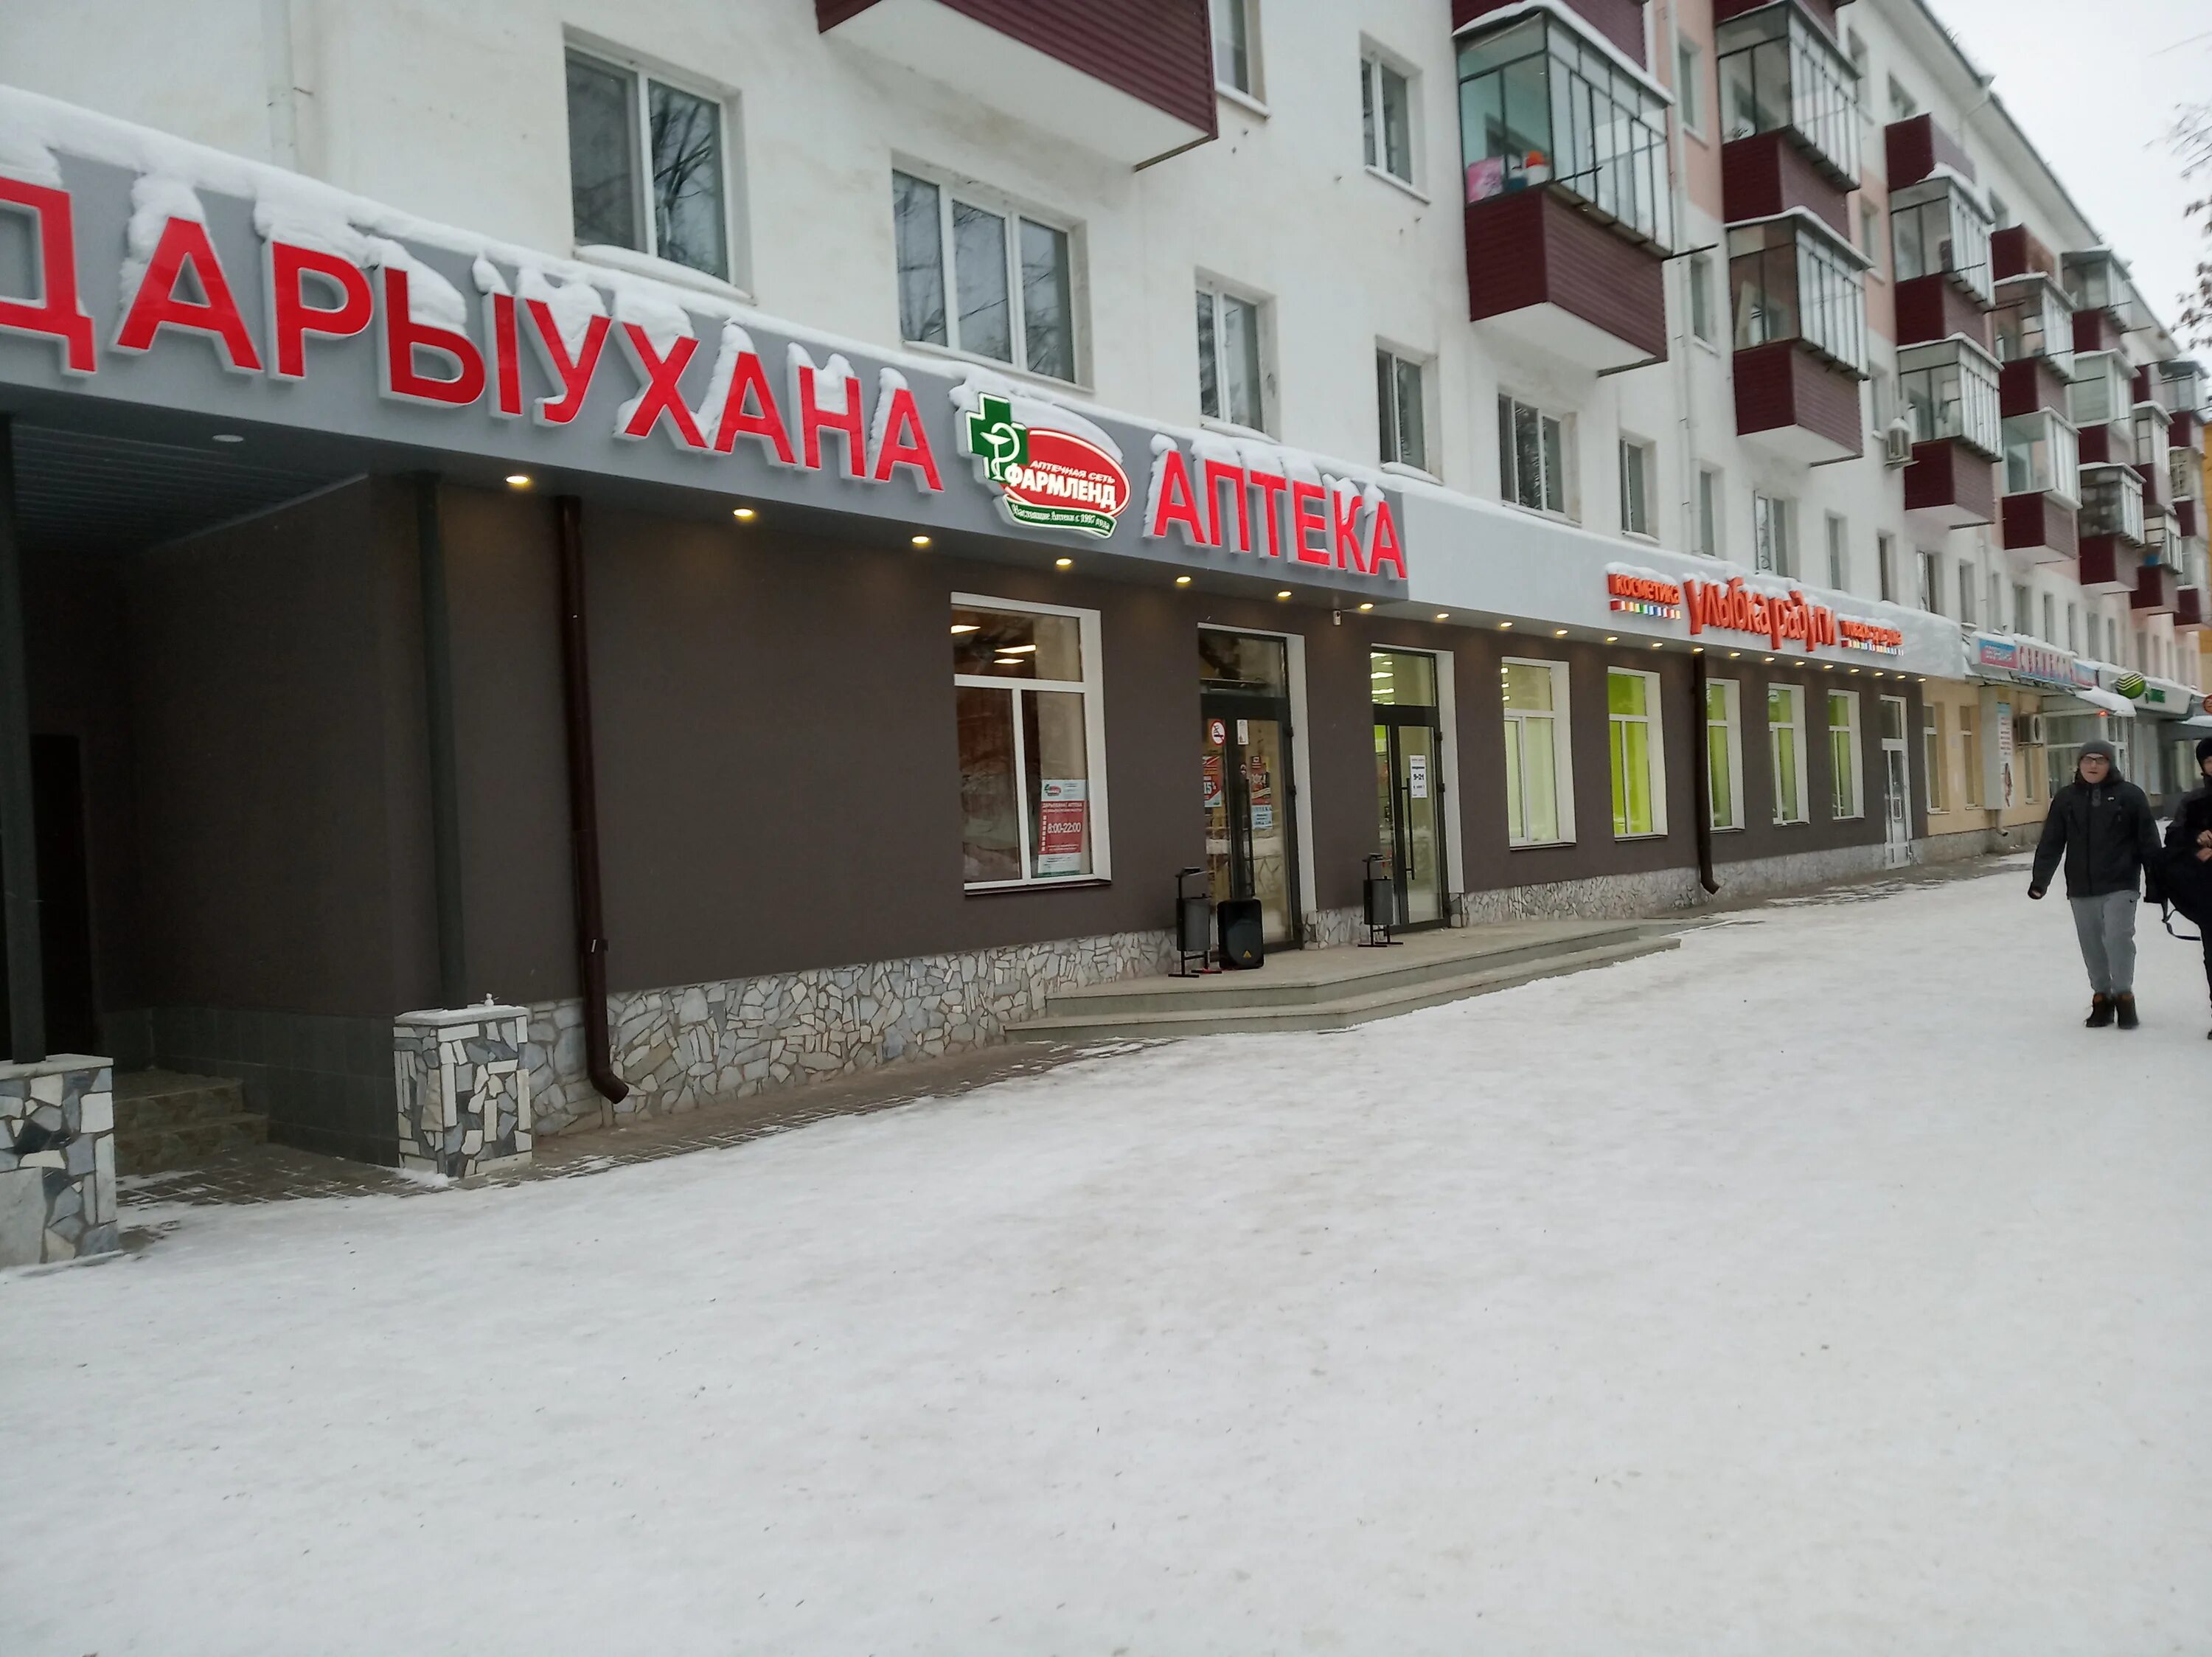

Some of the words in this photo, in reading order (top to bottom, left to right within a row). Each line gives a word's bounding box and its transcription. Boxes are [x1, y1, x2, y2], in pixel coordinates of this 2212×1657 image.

[1004, 462, 1117, 510] ФАРМЛЕНД
[1030, 460, 1087, 479] АПТЕЧНАЯ
[1088, 470, 1116, 484] СЕТЬ
[1152, 449, 1407, 580] АПТЕКА
[1048, 821, 1081, 834] 8:00-22:00
